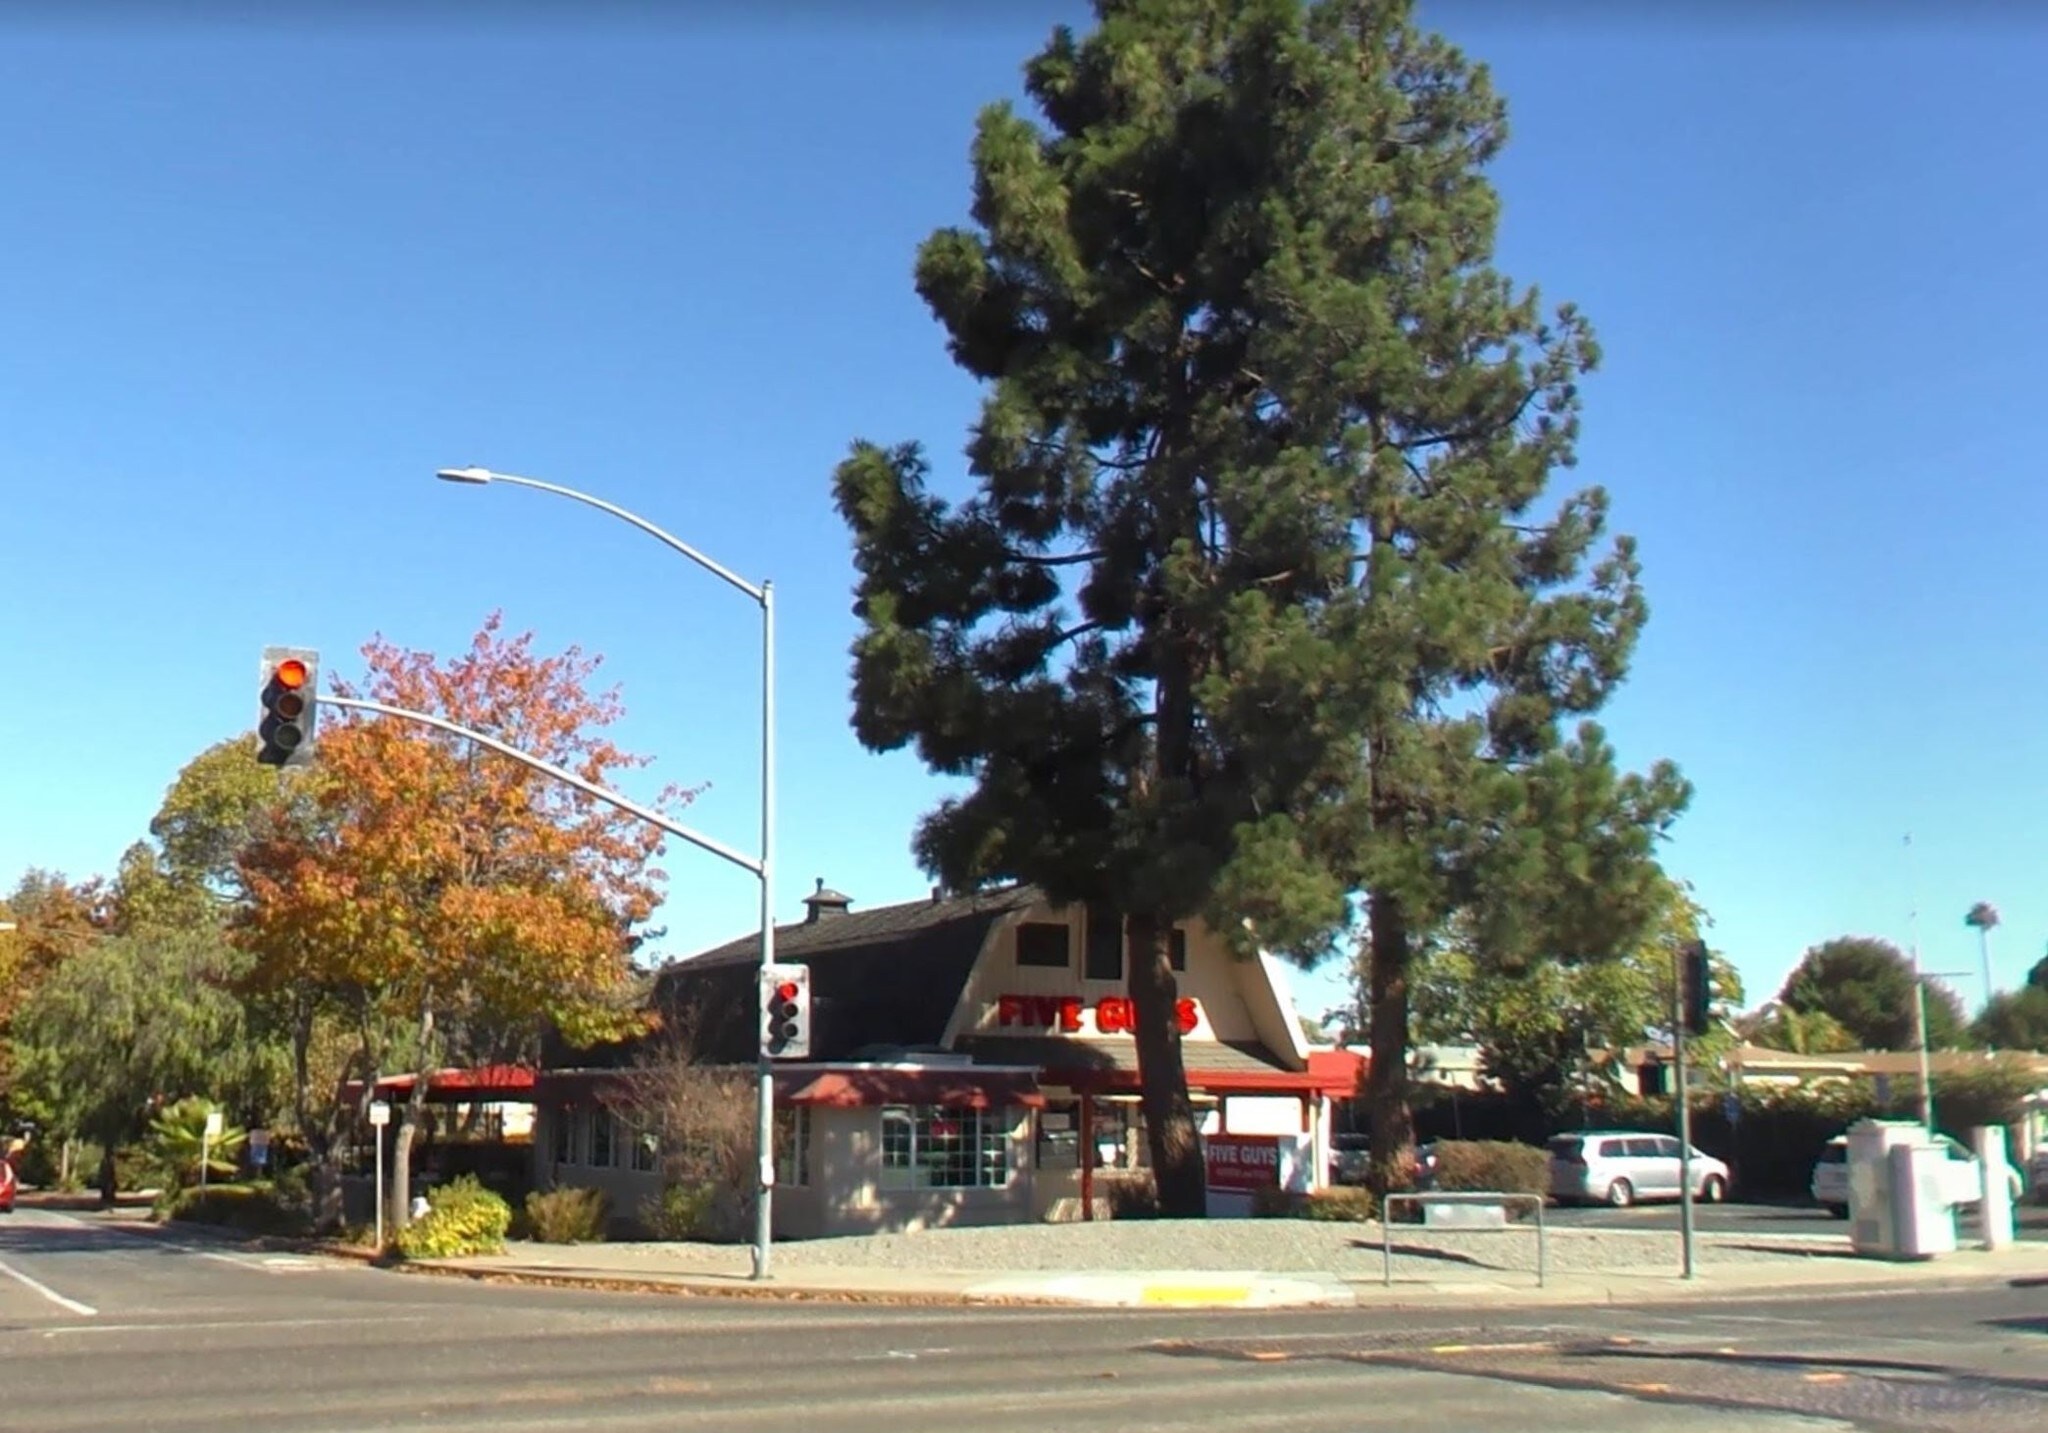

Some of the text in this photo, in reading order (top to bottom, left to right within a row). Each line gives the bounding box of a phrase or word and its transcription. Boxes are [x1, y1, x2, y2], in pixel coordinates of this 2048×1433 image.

[999, 994, 1199, 1035] FIVE GS
[1208, 1144, 1278, 1165] FIVE GUYS
